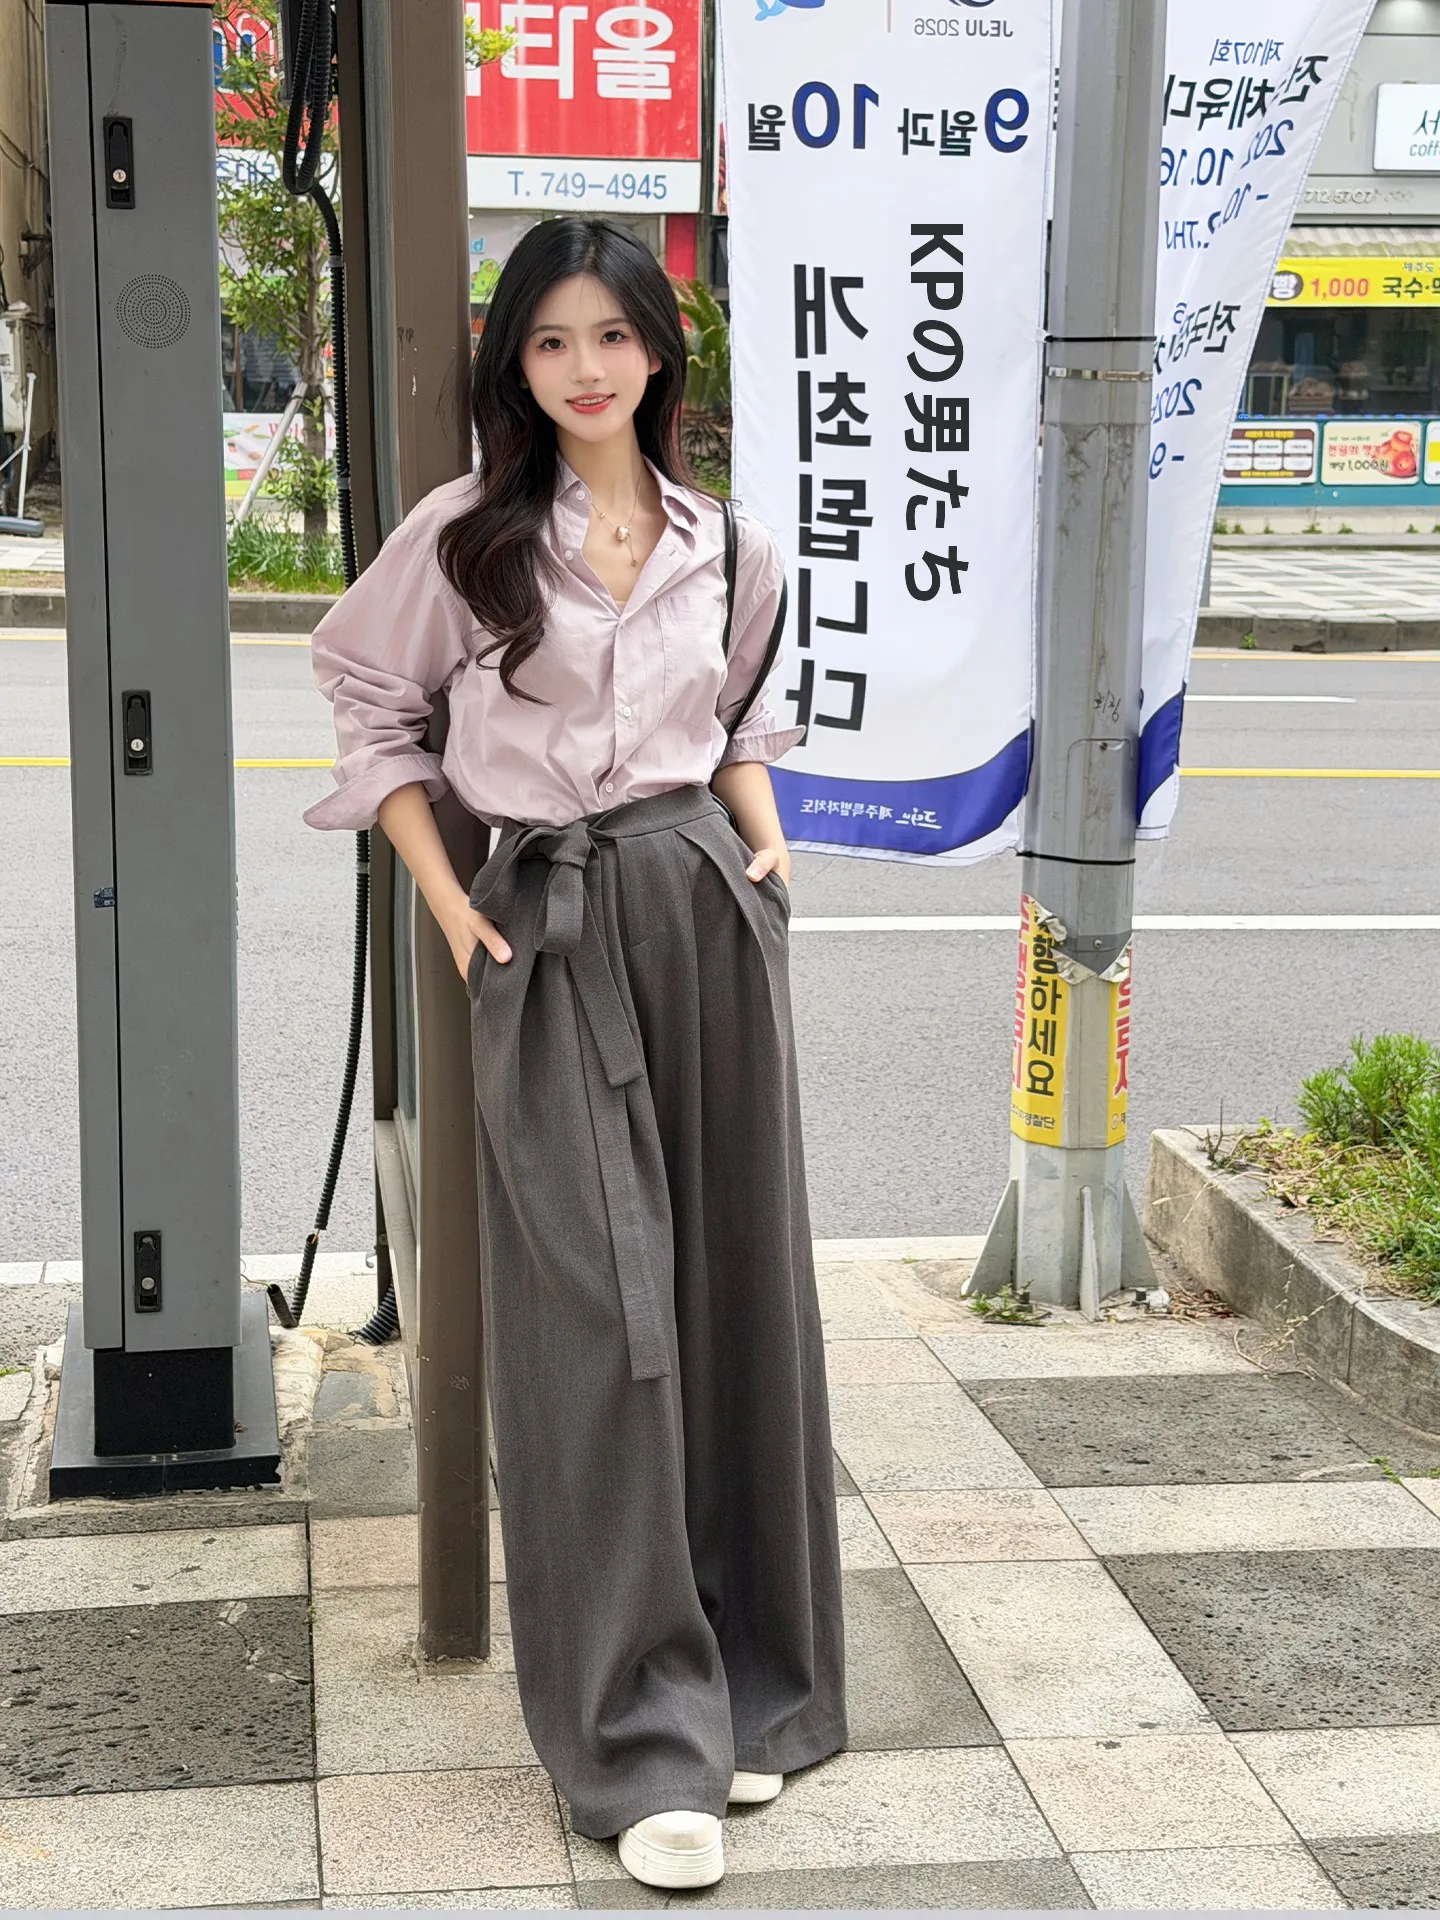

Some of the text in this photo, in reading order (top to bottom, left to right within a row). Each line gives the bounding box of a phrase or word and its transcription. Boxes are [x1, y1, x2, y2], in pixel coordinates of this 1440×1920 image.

[508, 171, 667, 200] T. 749-4945
[1311, 278, 1369, 300] 1,000
